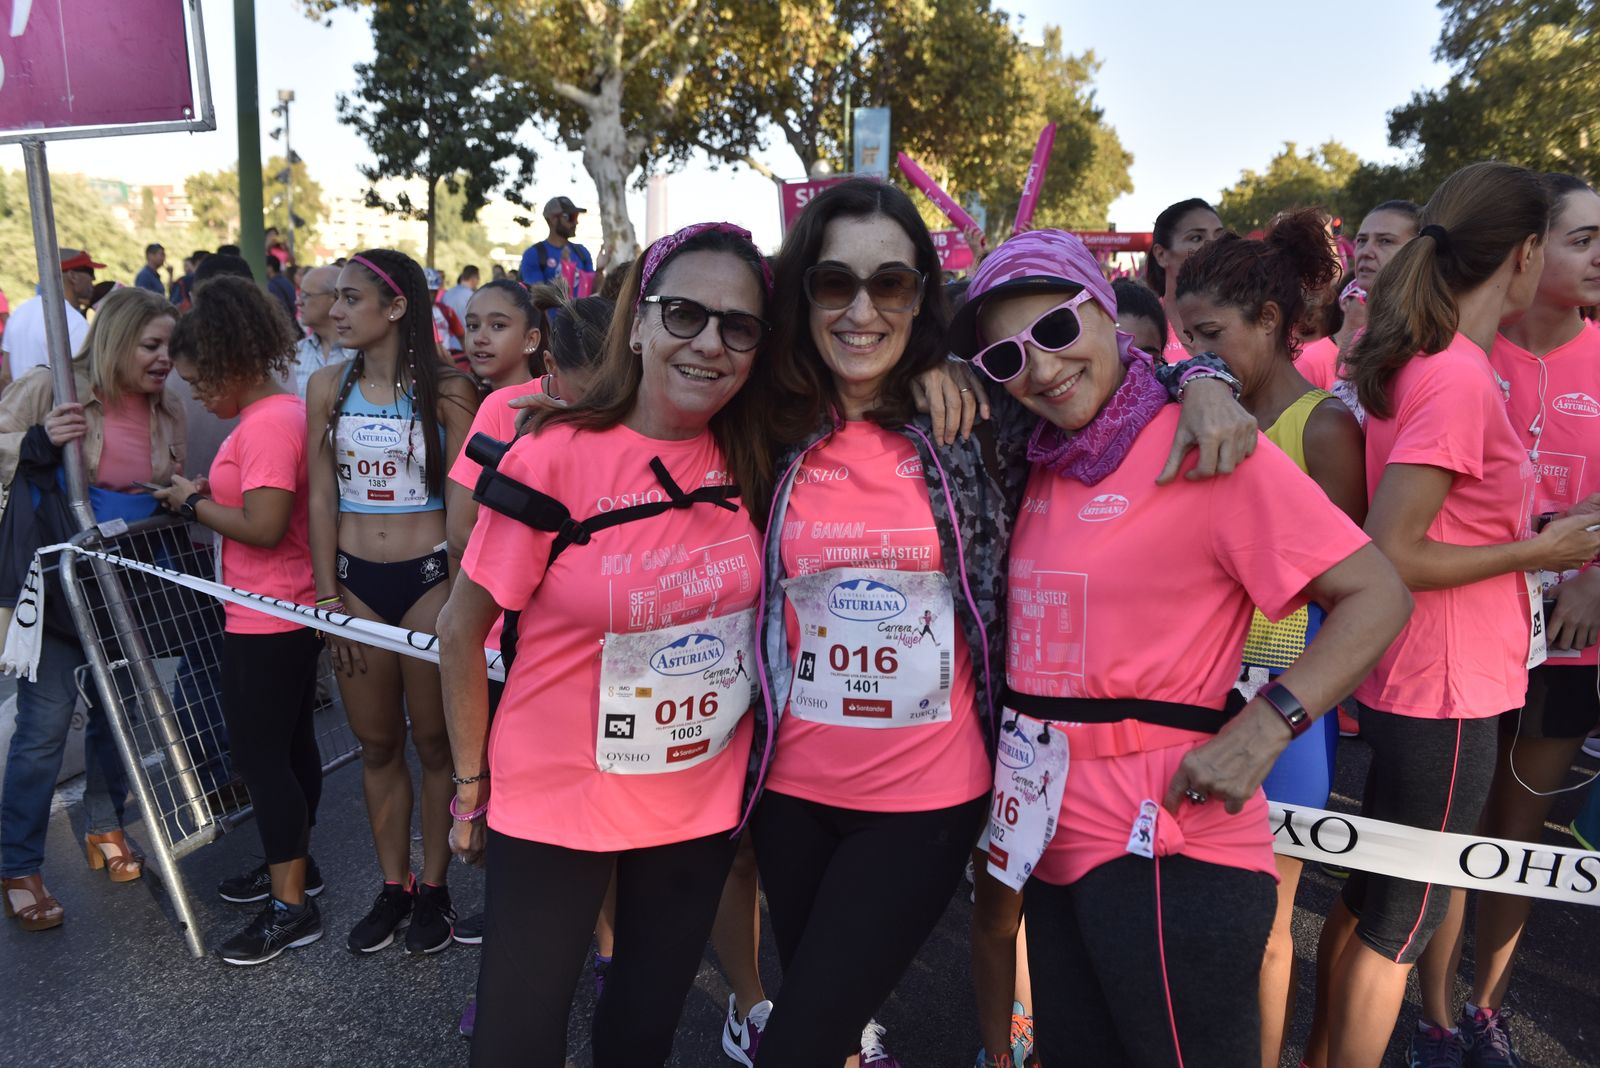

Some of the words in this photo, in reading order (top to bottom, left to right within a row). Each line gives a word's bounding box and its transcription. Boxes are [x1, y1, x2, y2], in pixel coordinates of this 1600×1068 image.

[356, 432, 397, 443] ASTURIANA
[357, 460, 397, 476] 016
[794, 466, 849, 484] OYSHO
[369, 479, 387, 488] 1383
[811, 520, 866, 539] GANAN
[601, 554, 632, 576] HOY
[641, 543, 690, 571] GANAN
[825, 548, 870, 560] VITORIA
[881, 547, 931, 560] GASTEIZ
[659, 569, 698, 590] VITORIA
[705, 556, 746, 577] GASTEIZ
[682, 576, 723, 598] MADRID
[830, 592, 900, 611] ASTURIANA
[1036, 591, 1068, 606] GASTEIZ
[877, 621, 912, 634] Carrera
[897, 633, 923, 648] Mujer
[656, 647, 721, 669] ASTURIANA
[829, 643, 899, 675] 016
[703, 667, 731, 680] Carrera
[718, 675, 738, 689] Mujer
[845, 679, 879, 694] 1401
[655, 691, 719, 726] 016
[796, 694, 828, 710] OYSHO
[856, 704, 886, 713] Santander
[909, 708, 939, 719] ZURICH
[670, 725, 703, 742] 1003
[606, 752, 650, 763] OYSHO
